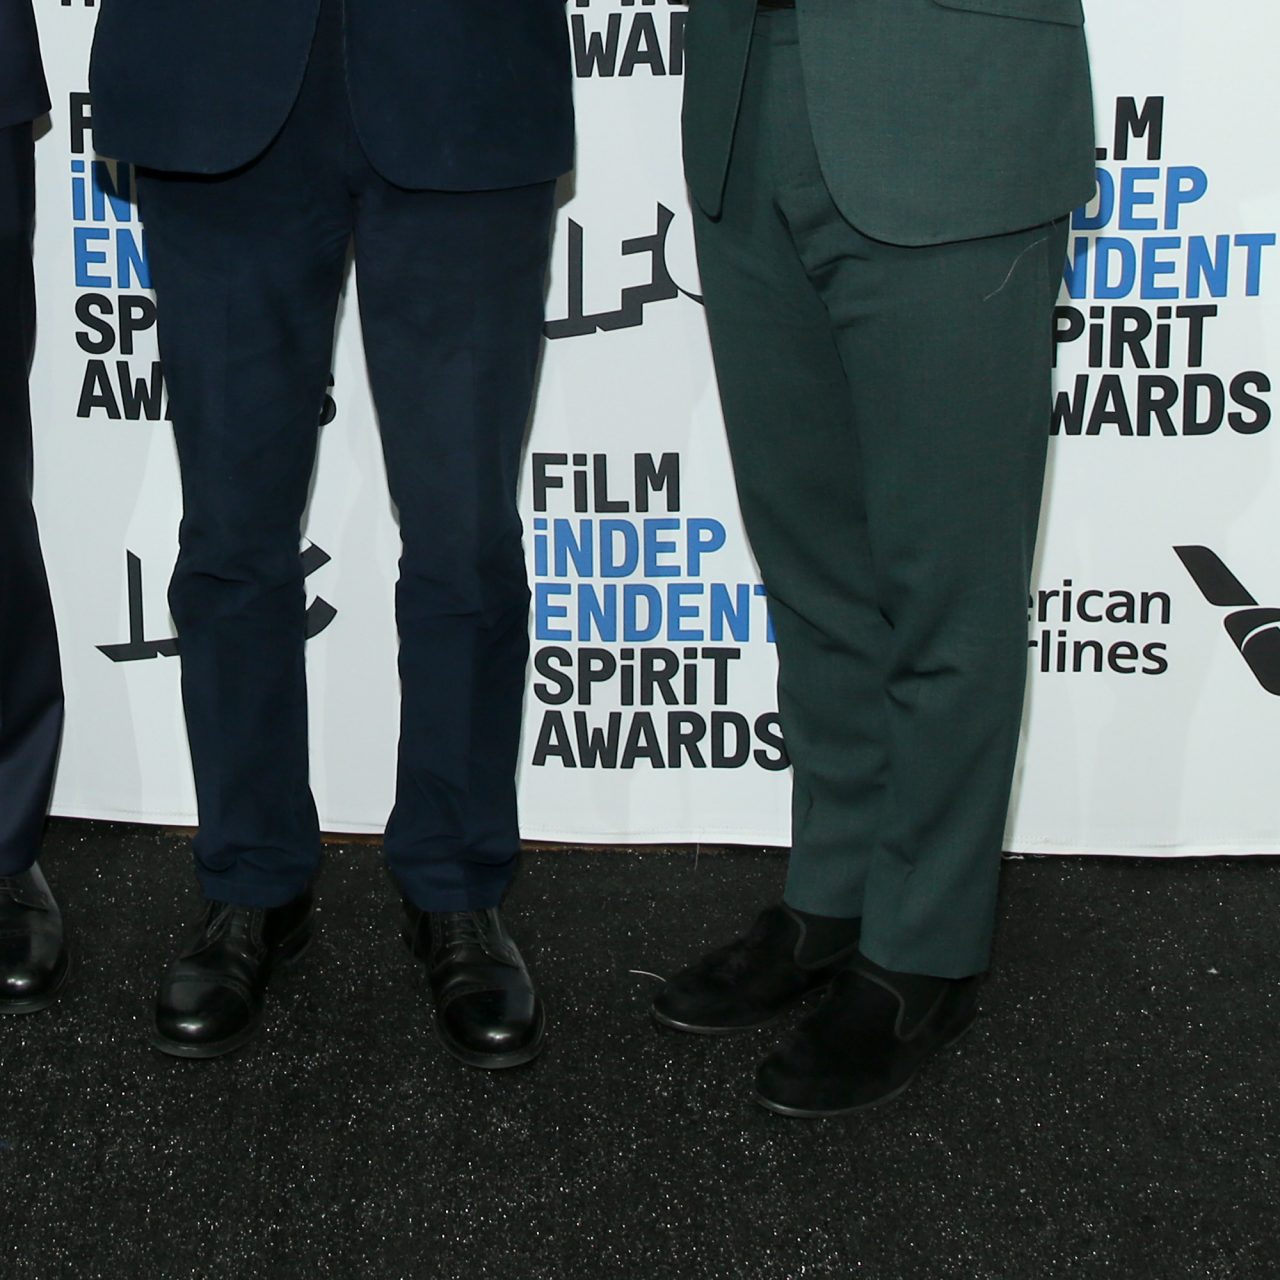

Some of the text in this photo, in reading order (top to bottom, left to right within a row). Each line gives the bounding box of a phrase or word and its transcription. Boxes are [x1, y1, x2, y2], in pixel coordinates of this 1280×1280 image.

[1051, 304, 1218, 369] PiRiT
[1049, 370, 1273, 437] WARDS
[531, 451, 681, 513] FiLM
[533, 517, 727, 578] iNDEP
[533, 645, 741, 706] SPiRiT
[532, 709, 793, 772] AWARDS
